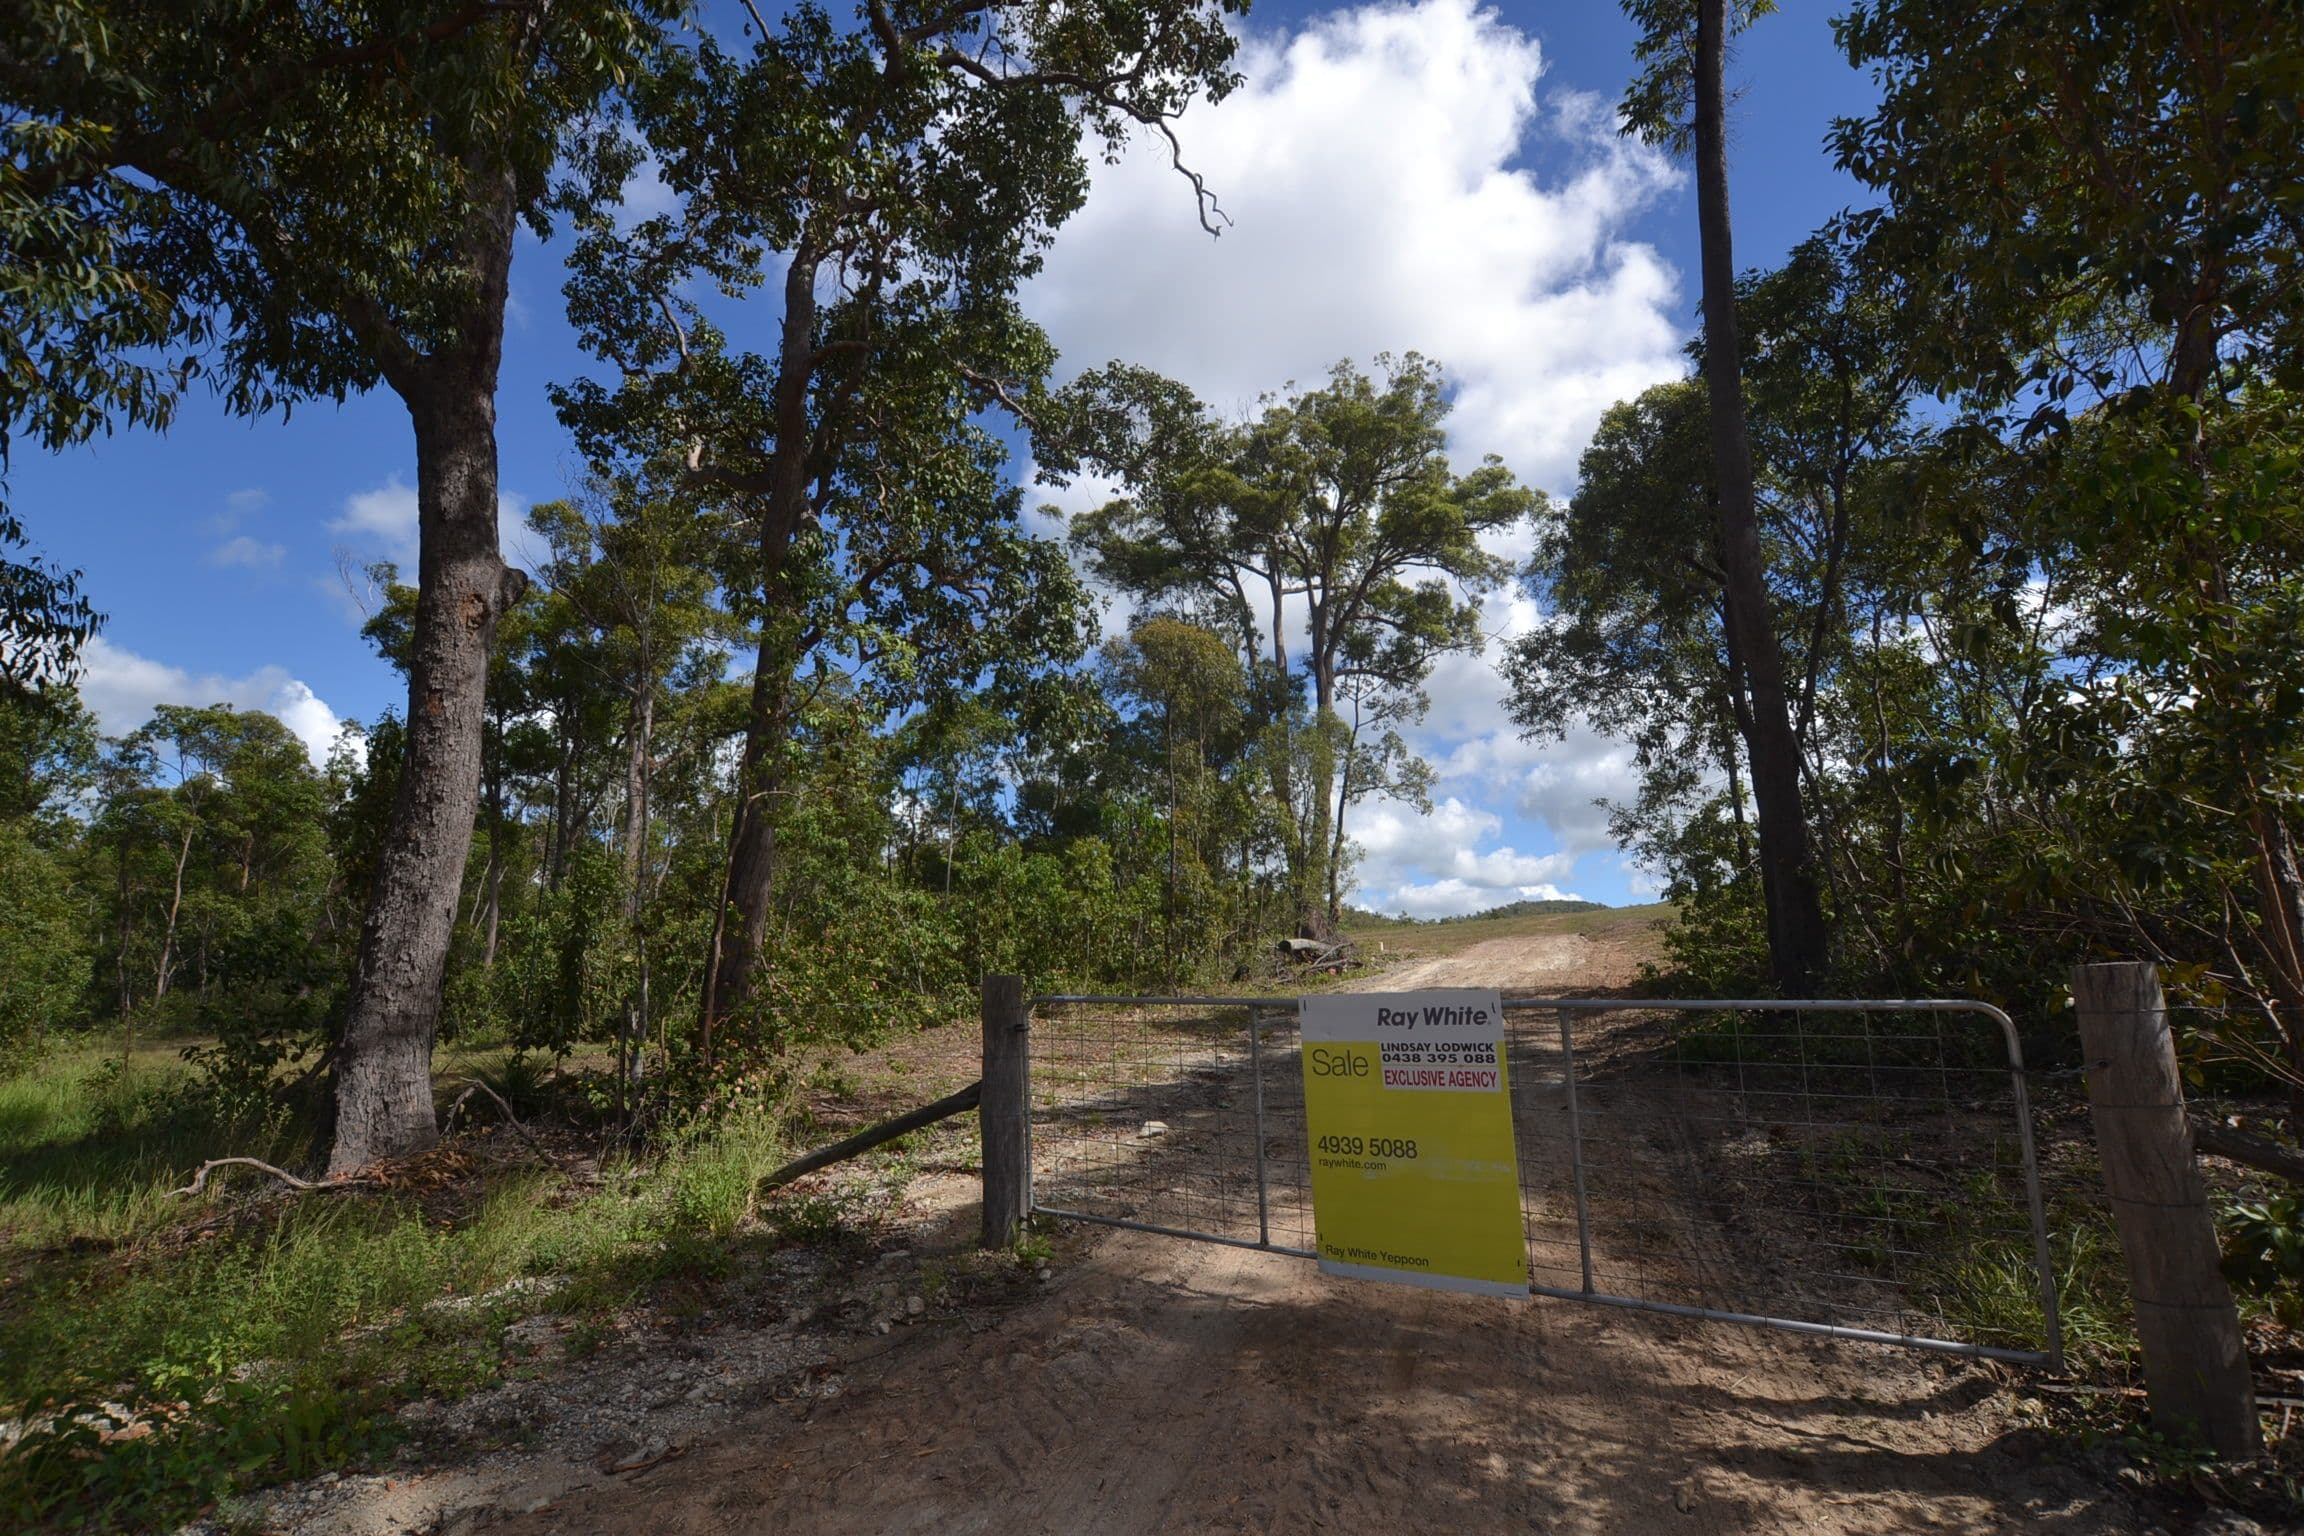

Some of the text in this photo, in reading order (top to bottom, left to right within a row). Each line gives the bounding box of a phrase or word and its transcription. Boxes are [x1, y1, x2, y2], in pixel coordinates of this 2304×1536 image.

[1377, 1007, 1488, 1029] Ray White
[1381, 1042, 1494, 1053] LINDSAY LODWICK
[1312, 1048, 1369, 1076] Sale
[1382, 1053, 1496, 1064] 0438 395 088
[1384, 1069, 1497, 1088] EXCLUSIVE AGENCY
[1318, 1135, 1418, 1159] 4939 5088
[1318, 1158, 1387, 1171] raywhite.com
[1325, 1244, 1429, 1267] Ray White Yeppoon
